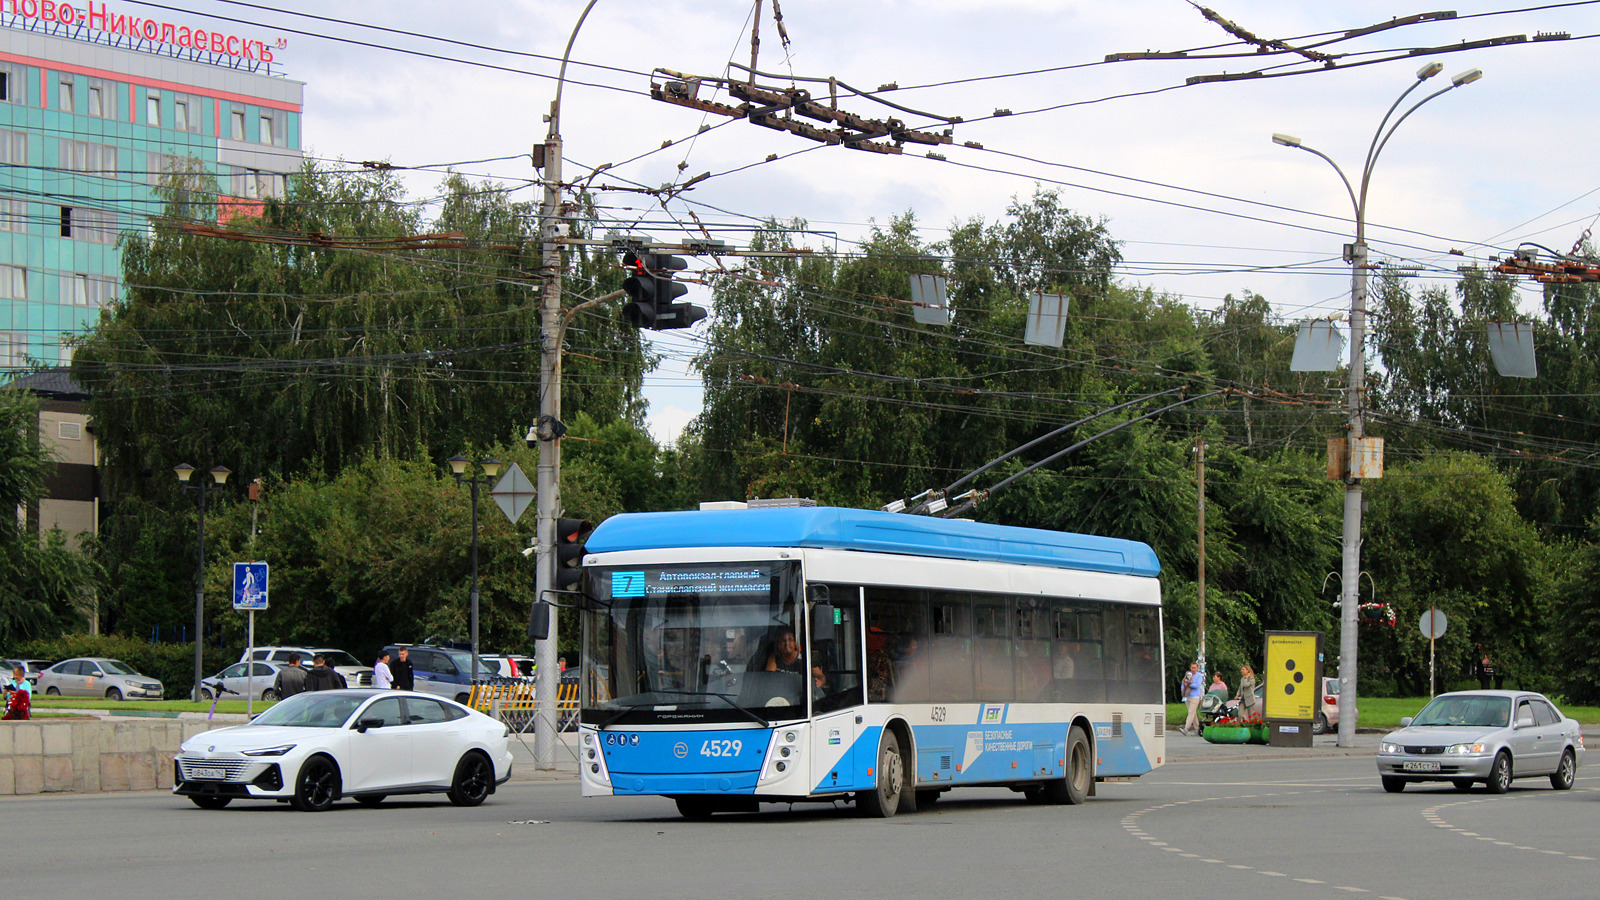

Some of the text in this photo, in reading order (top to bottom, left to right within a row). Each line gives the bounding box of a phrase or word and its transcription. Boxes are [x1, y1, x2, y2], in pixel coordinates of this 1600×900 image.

[622, 576, 633, 593] 7
[931, 707, 947, 722] 4529
[985, 730, 1012, 740] БЕЗОПАСНЫЕ
[700, 740, 743, 757] 4529
[1017, 740, 1033, 752] ДОРОГИ
